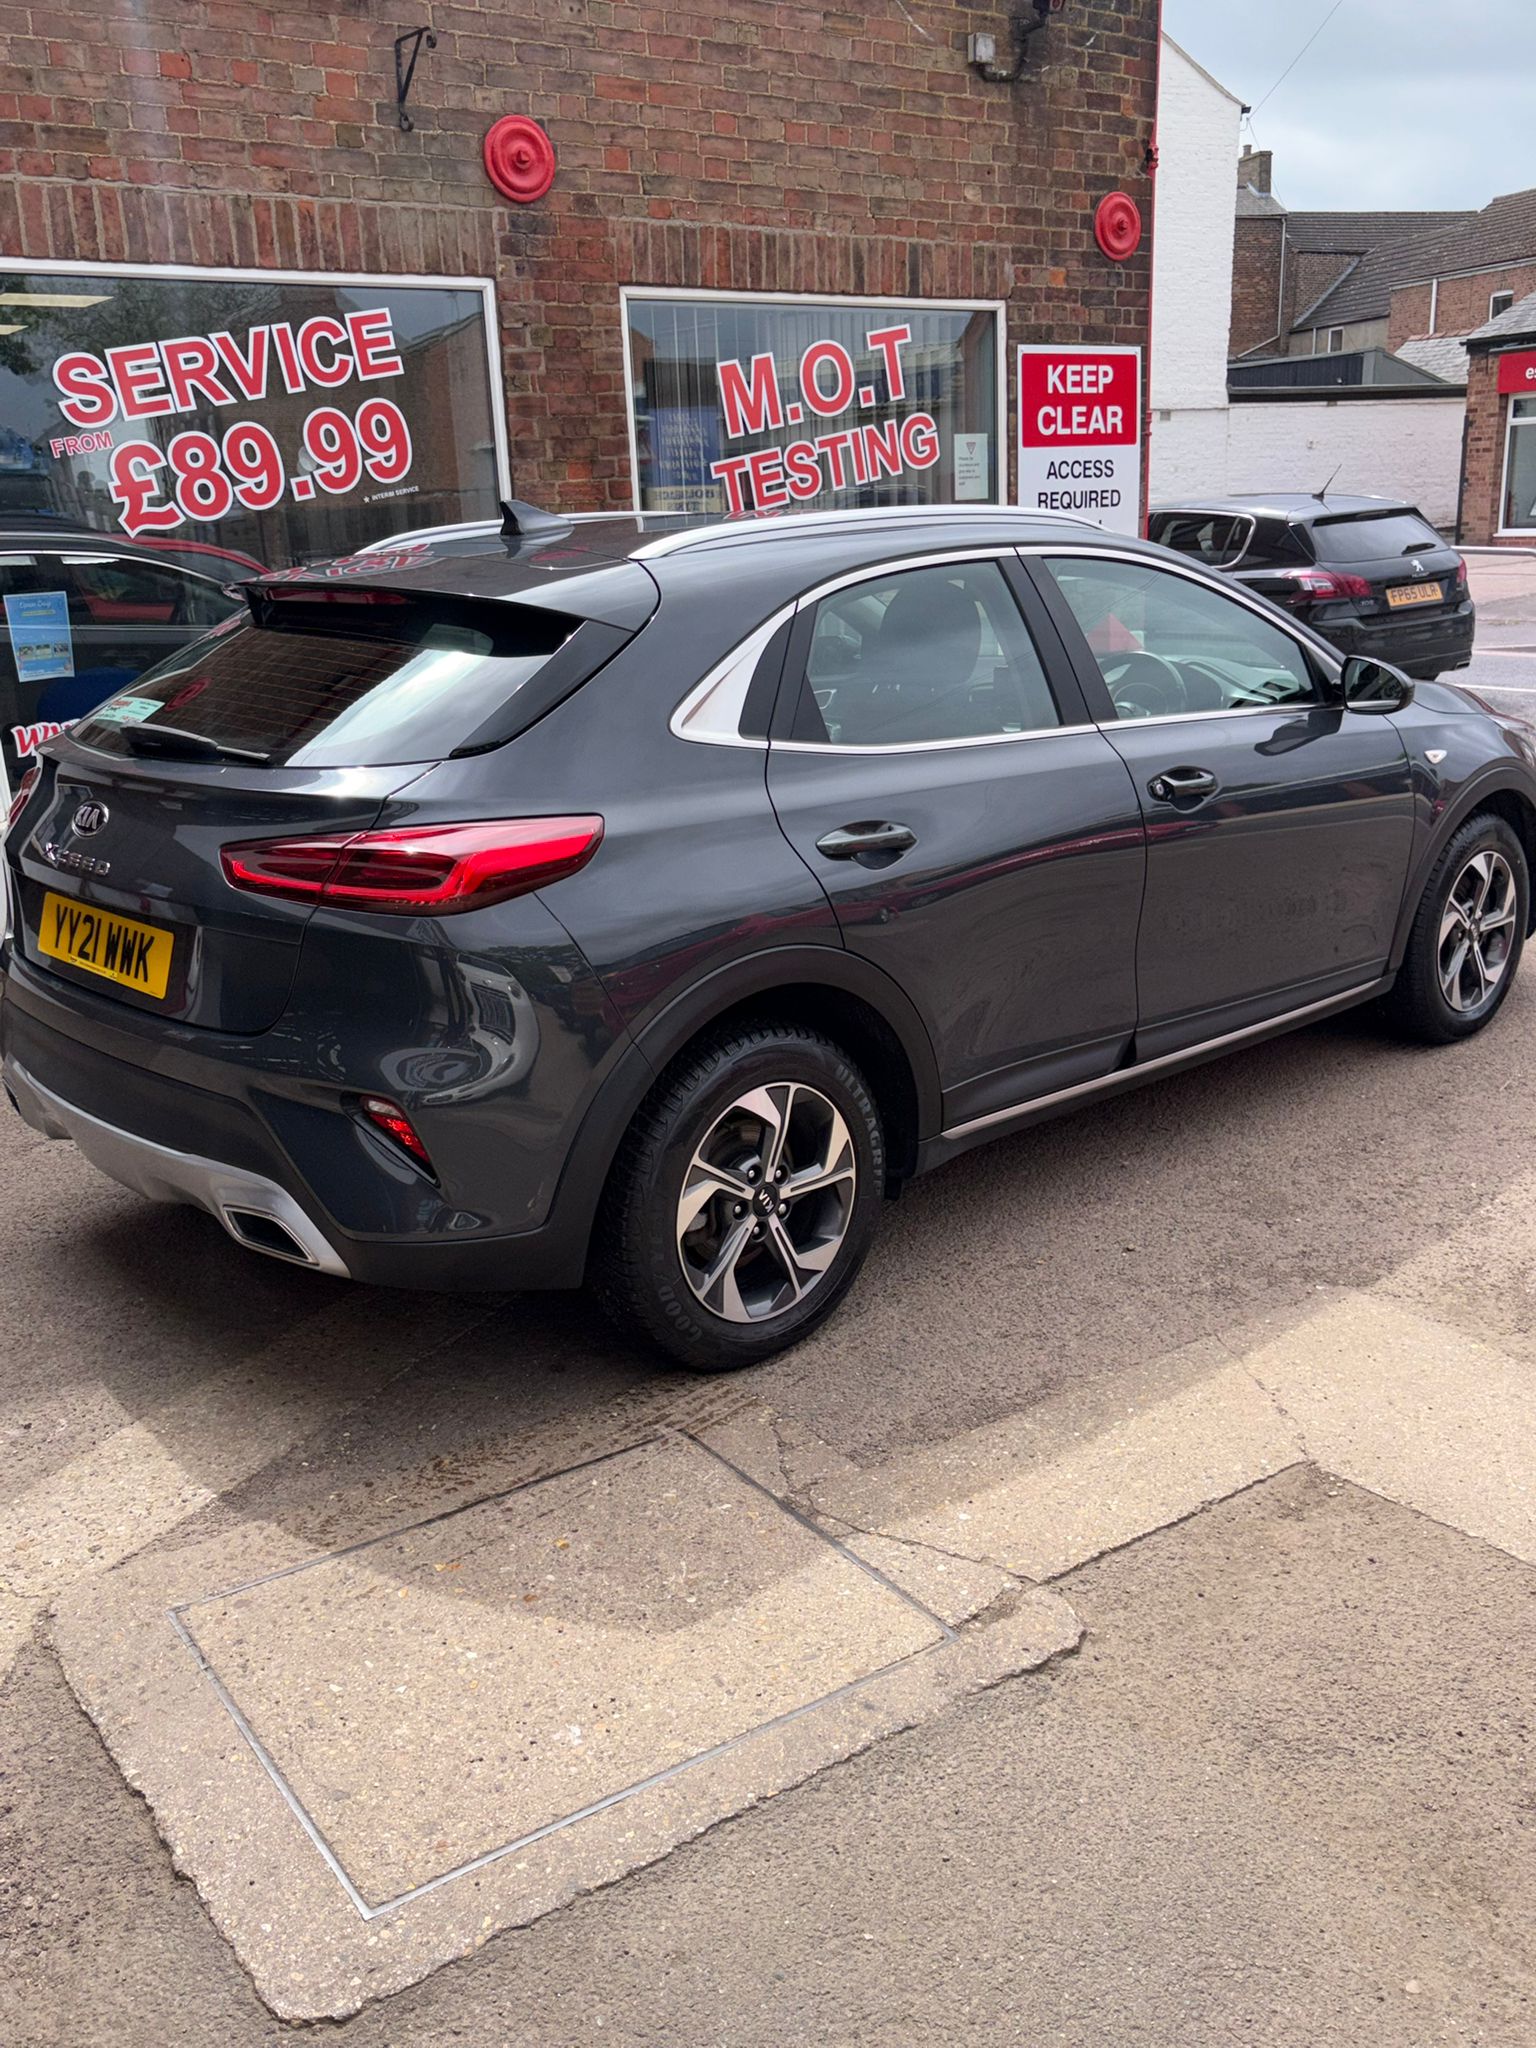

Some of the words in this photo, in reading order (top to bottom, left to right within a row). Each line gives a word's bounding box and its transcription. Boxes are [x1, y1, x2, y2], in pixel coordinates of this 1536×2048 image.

[52, 307, 404, 428] SERVICE
[716, 323, 912, 439] M.O.T
[1046, 363, 1114, 394] KEEP
[1036, 405, 1123, 436] CLEAR
[50, 431, 114, 459] FROM
[107, 397, 413, 538] £89.99
[710, 412, 940, 513] TESTING
[1046, 459, 1115, 480] ACCESS
[371, 491, 395, 501] INTERIM
[395, 486, 419, 496] SERVICE
[1037, 489, 1121, 510] REQUIRED
[1390, 586, 1418, 603] FP65
[1418, 584, 1437, 599] ULR
[74, 805, 100, 830] KIA
[54, 903, 103, 964] YY21
[103, 921, 155, 983] WWK
[757, 1188, 775, 1213] KIA
